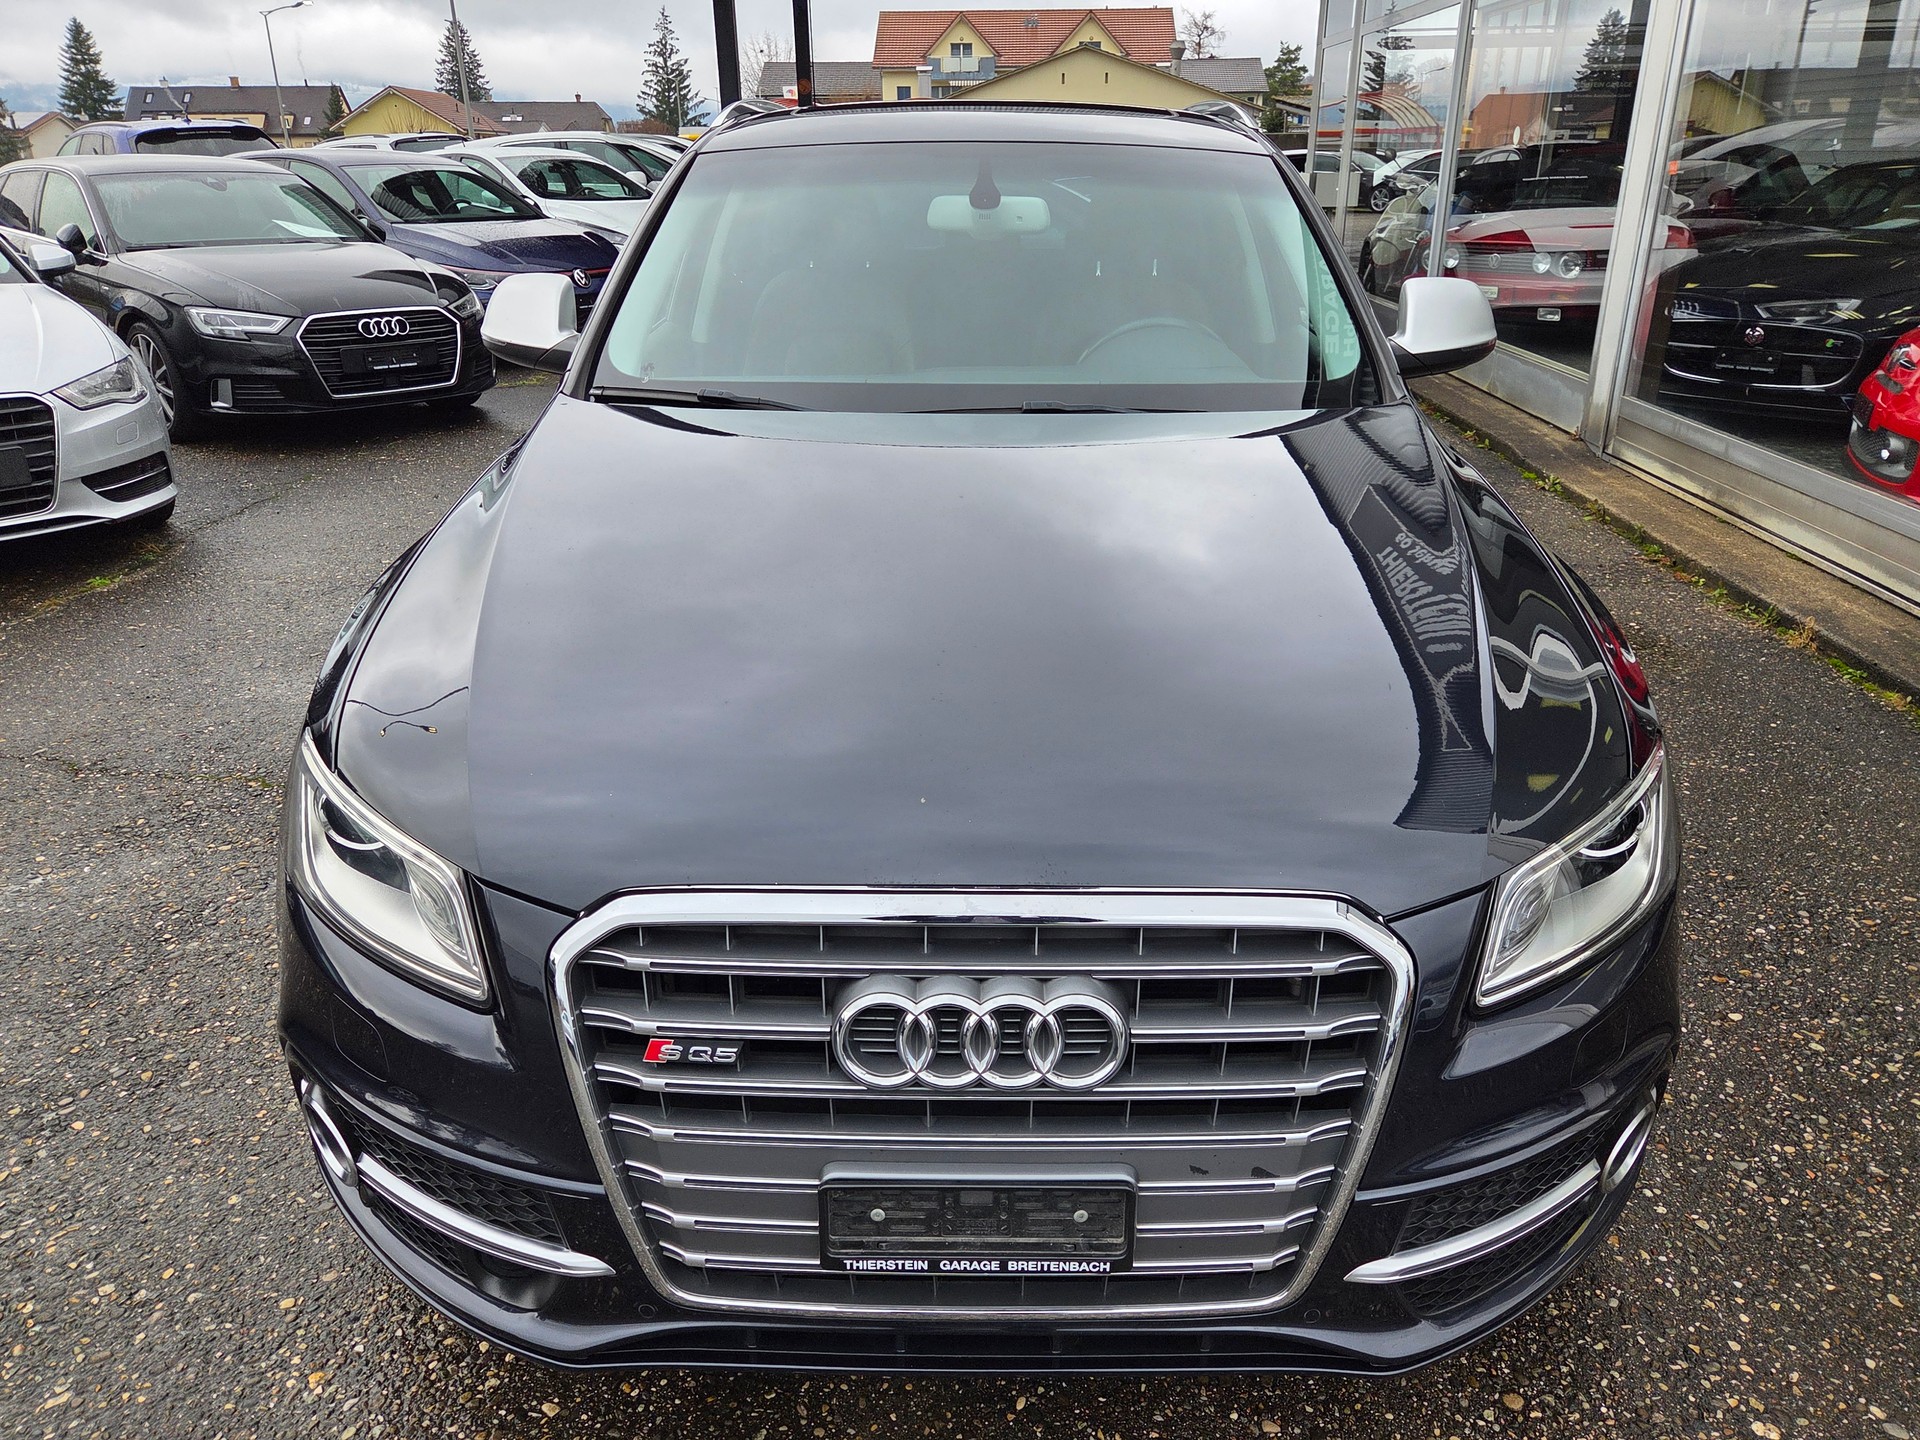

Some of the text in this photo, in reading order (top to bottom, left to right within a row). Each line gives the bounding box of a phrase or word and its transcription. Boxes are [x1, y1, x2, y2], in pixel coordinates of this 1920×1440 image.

[843, 1260, 1111, 1272] THIERSTEIN GARAGE BREITENBACH
